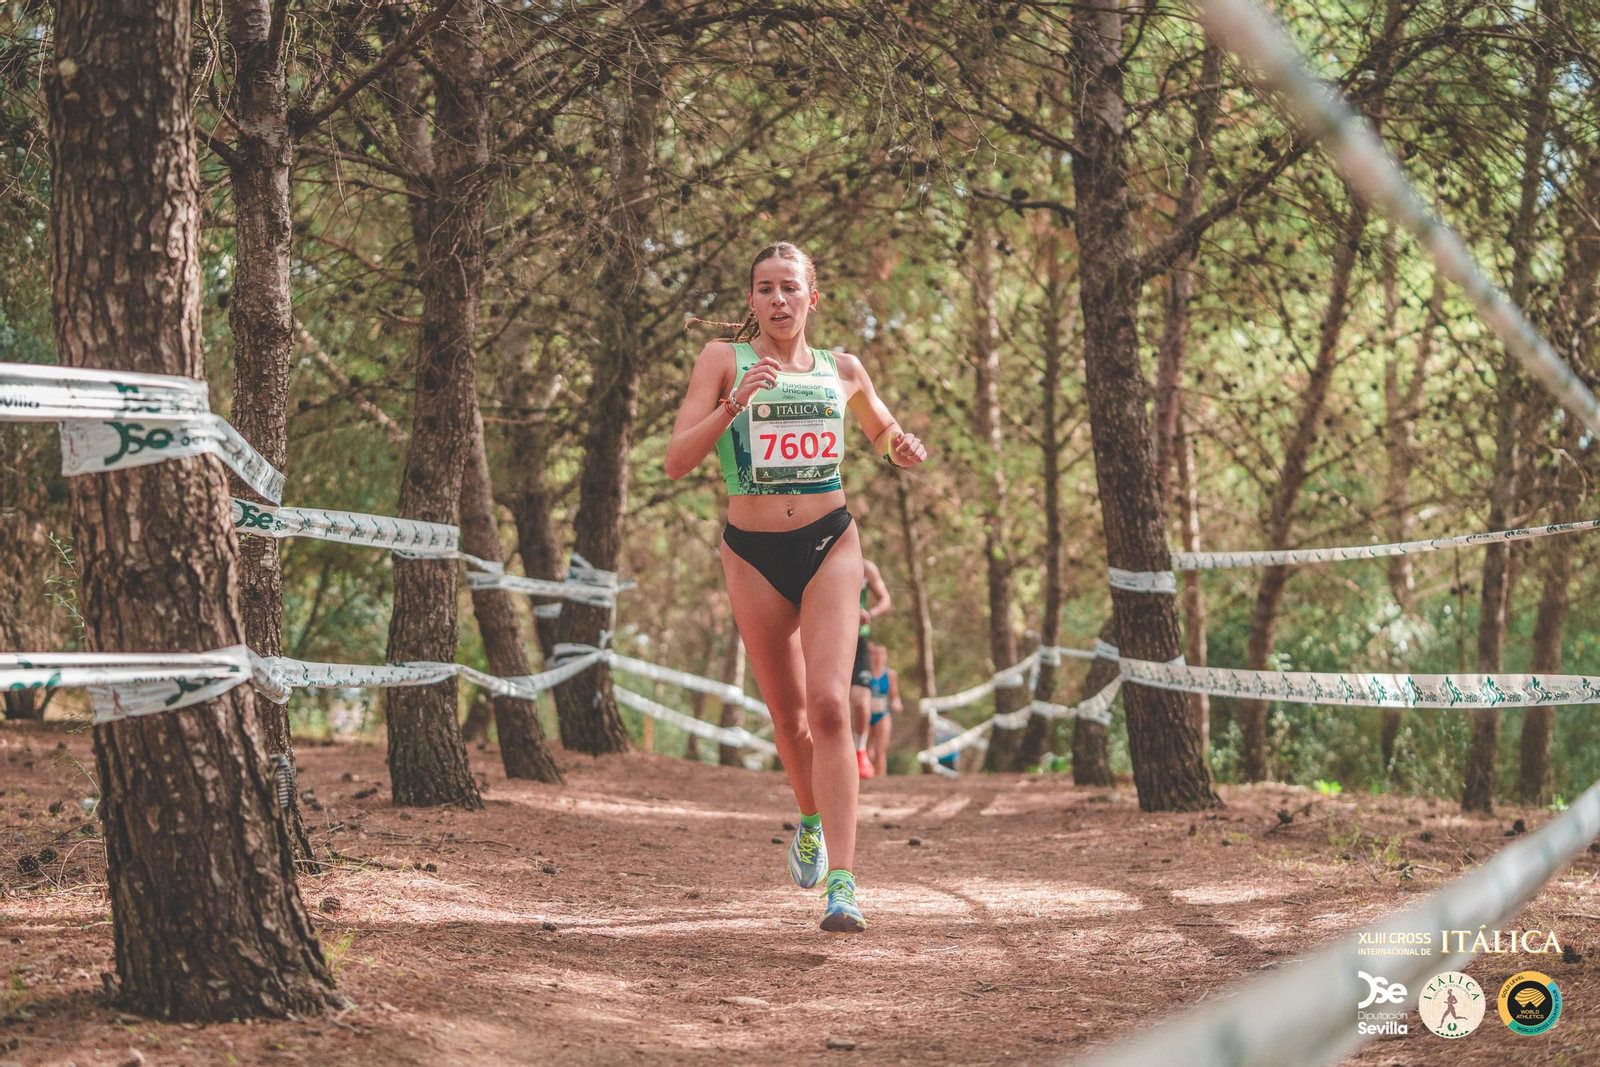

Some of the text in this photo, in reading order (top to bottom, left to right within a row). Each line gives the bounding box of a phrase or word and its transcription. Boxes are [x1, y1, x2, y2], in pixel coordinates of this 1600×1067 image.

[782, 382, 824, 390] Fundación
[782, 387, 814, 397] Unicaja
[776, 403, 820, 415] ITÁLICA
[759, 432, 839, 460] 7602
